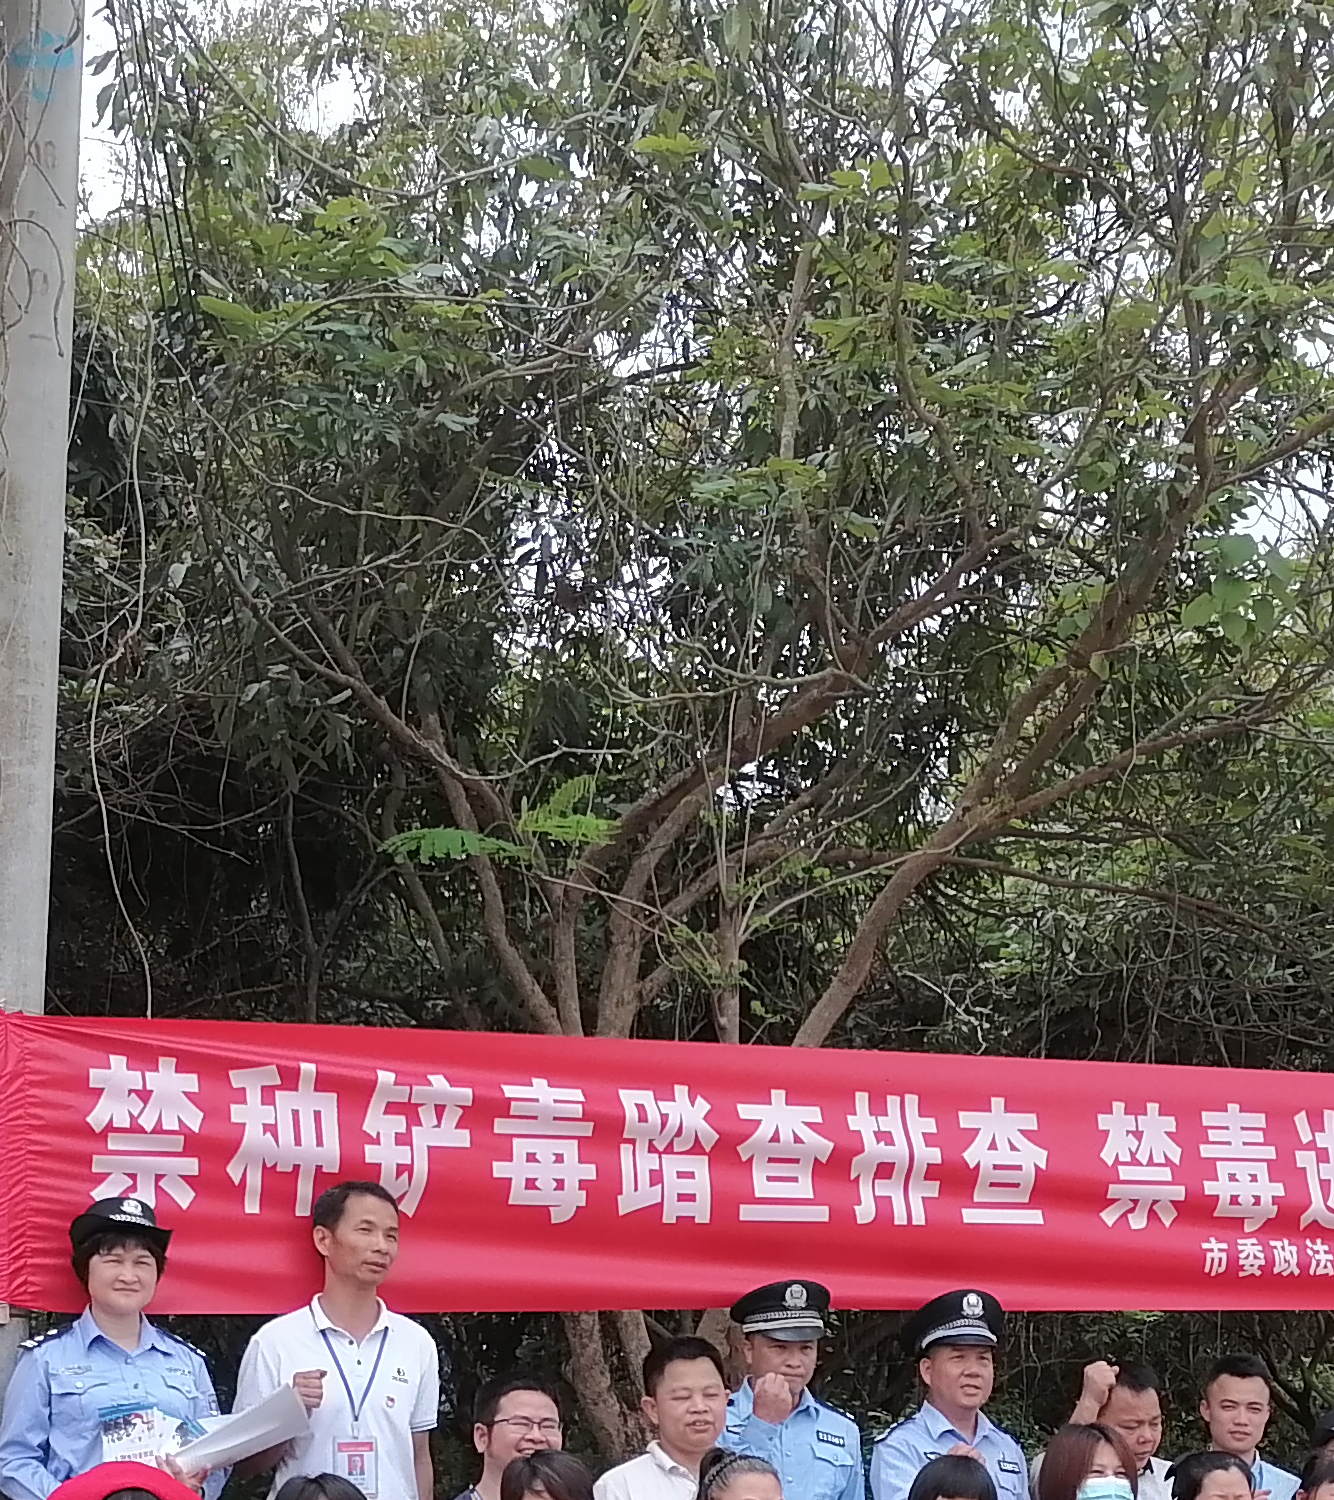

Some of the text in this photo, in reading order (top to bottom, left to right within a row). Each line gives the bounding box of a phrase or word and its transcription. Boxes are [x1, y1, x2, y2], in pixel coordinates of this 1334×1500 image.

[86, 1054, 1048, 1226] 禁种铲毒踏查排查
